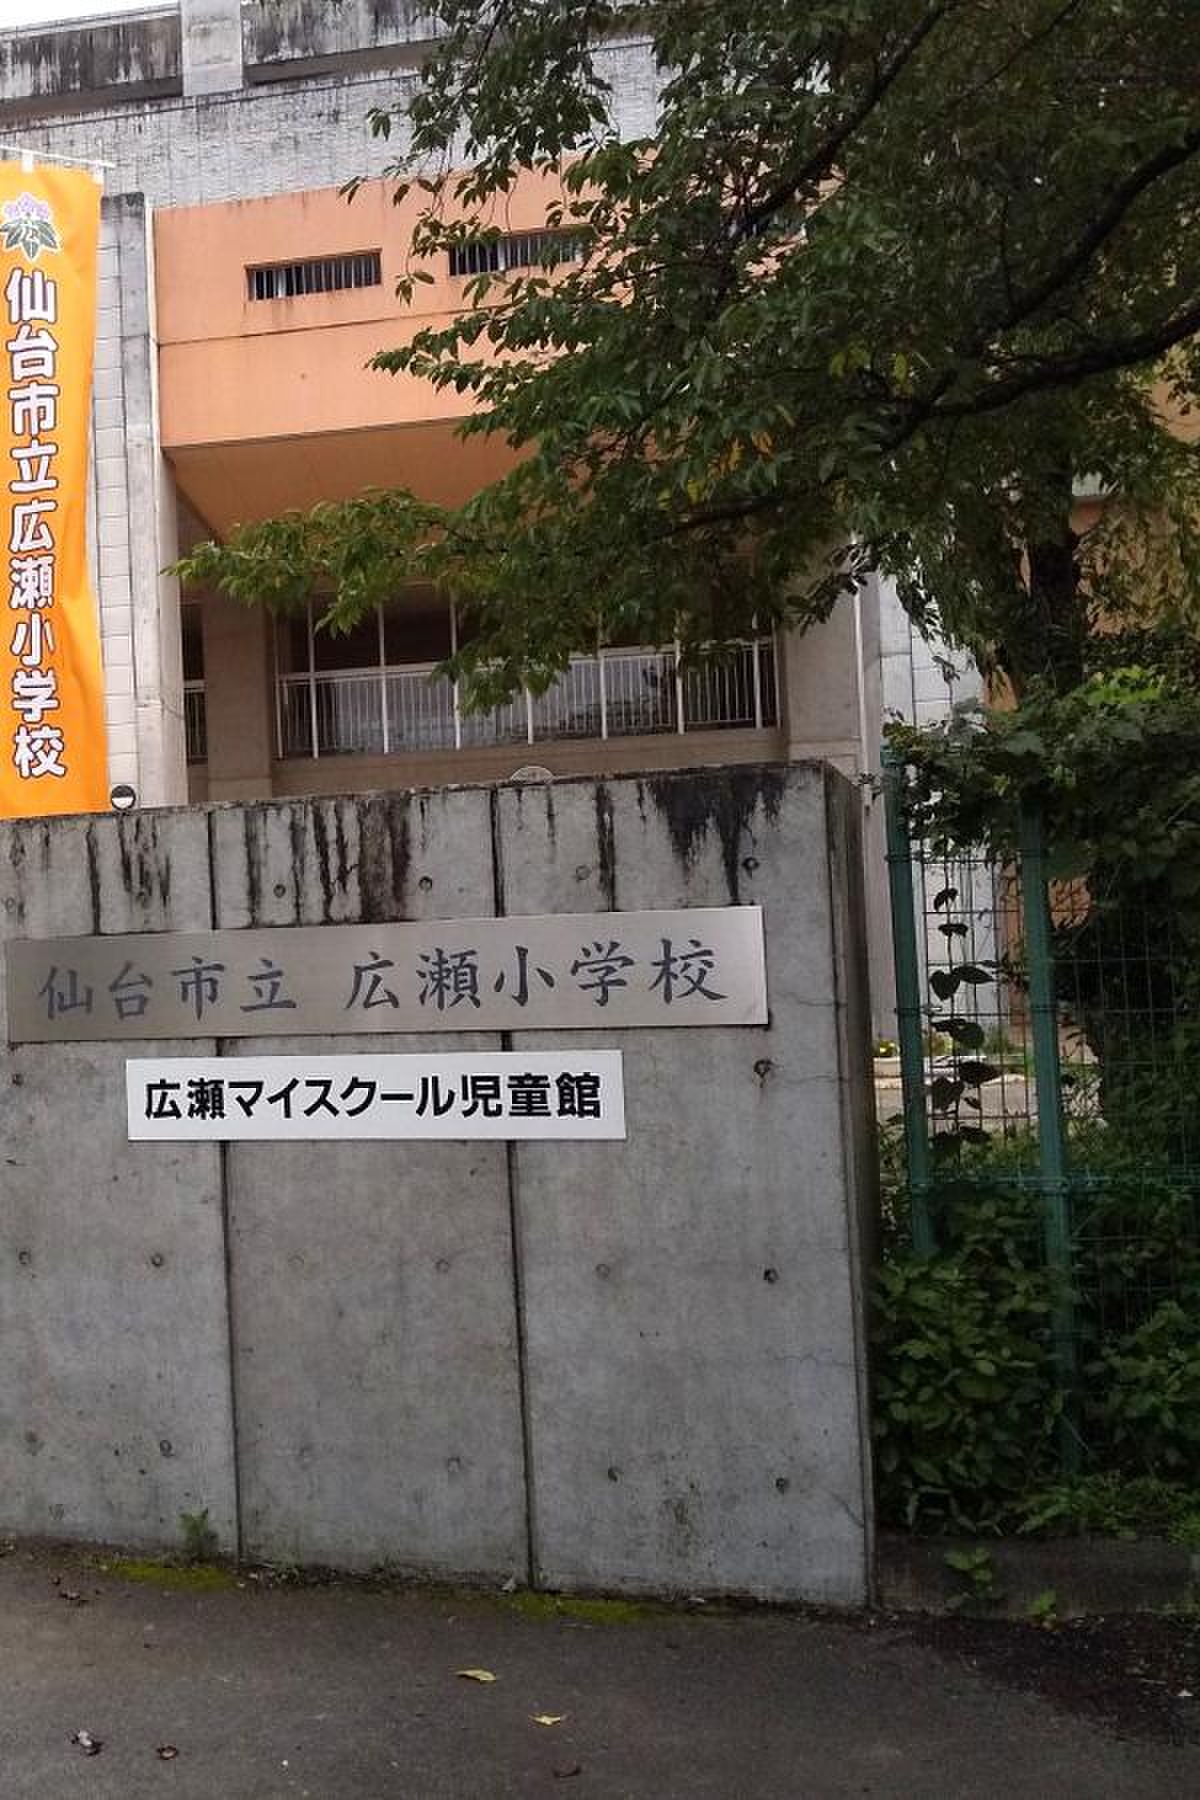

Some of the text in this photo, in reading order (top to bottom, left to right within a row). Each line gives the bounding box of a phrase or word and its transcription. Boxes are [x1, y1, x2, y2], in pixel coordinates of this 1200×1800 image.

[4, 267, 68, 778] 仙台市立広瀬小学校
[37, 938, 729, 1021] 仙台市立 広瀬小学校
[144, 1071, 602, 1122] 広瀬マイスクール児童館
